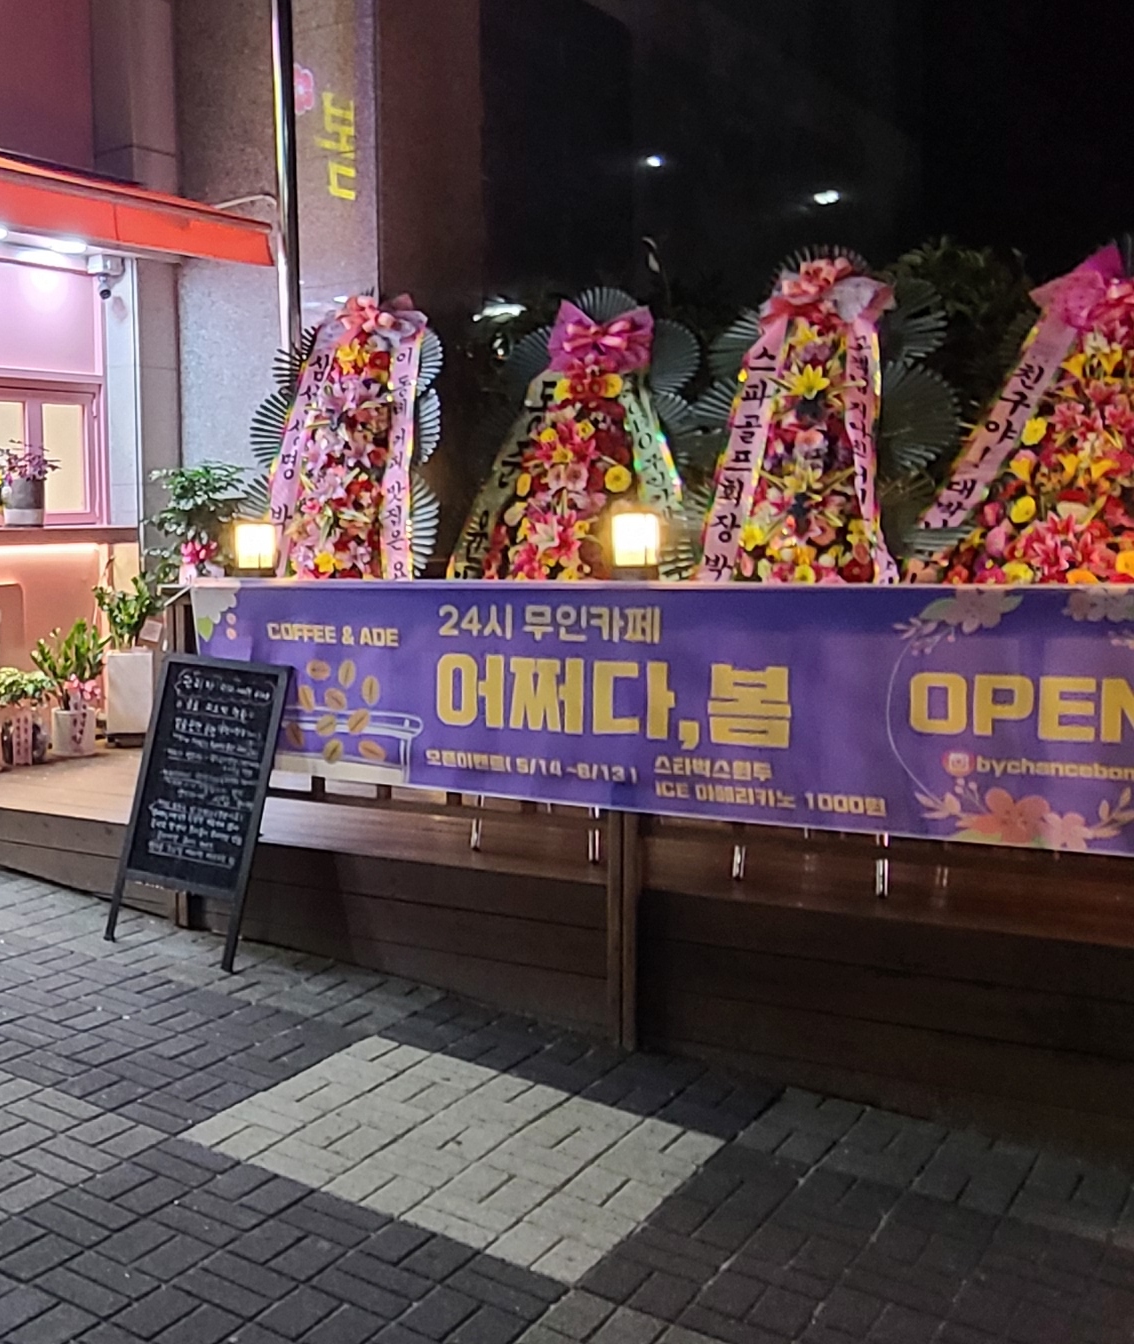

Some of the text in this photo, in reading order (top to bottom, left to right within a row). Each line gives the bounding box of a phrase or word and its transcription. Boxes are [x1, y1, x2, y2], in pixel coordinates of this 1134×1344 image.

[266, 622, 400, 648] COFFEE & ADE
[438, 604, 661, 645] 24시 무인카페
[654, 756, 773, 782] 스타벅스원두
[655, 780, 887, 818] ICE 아메리카노 1000원
